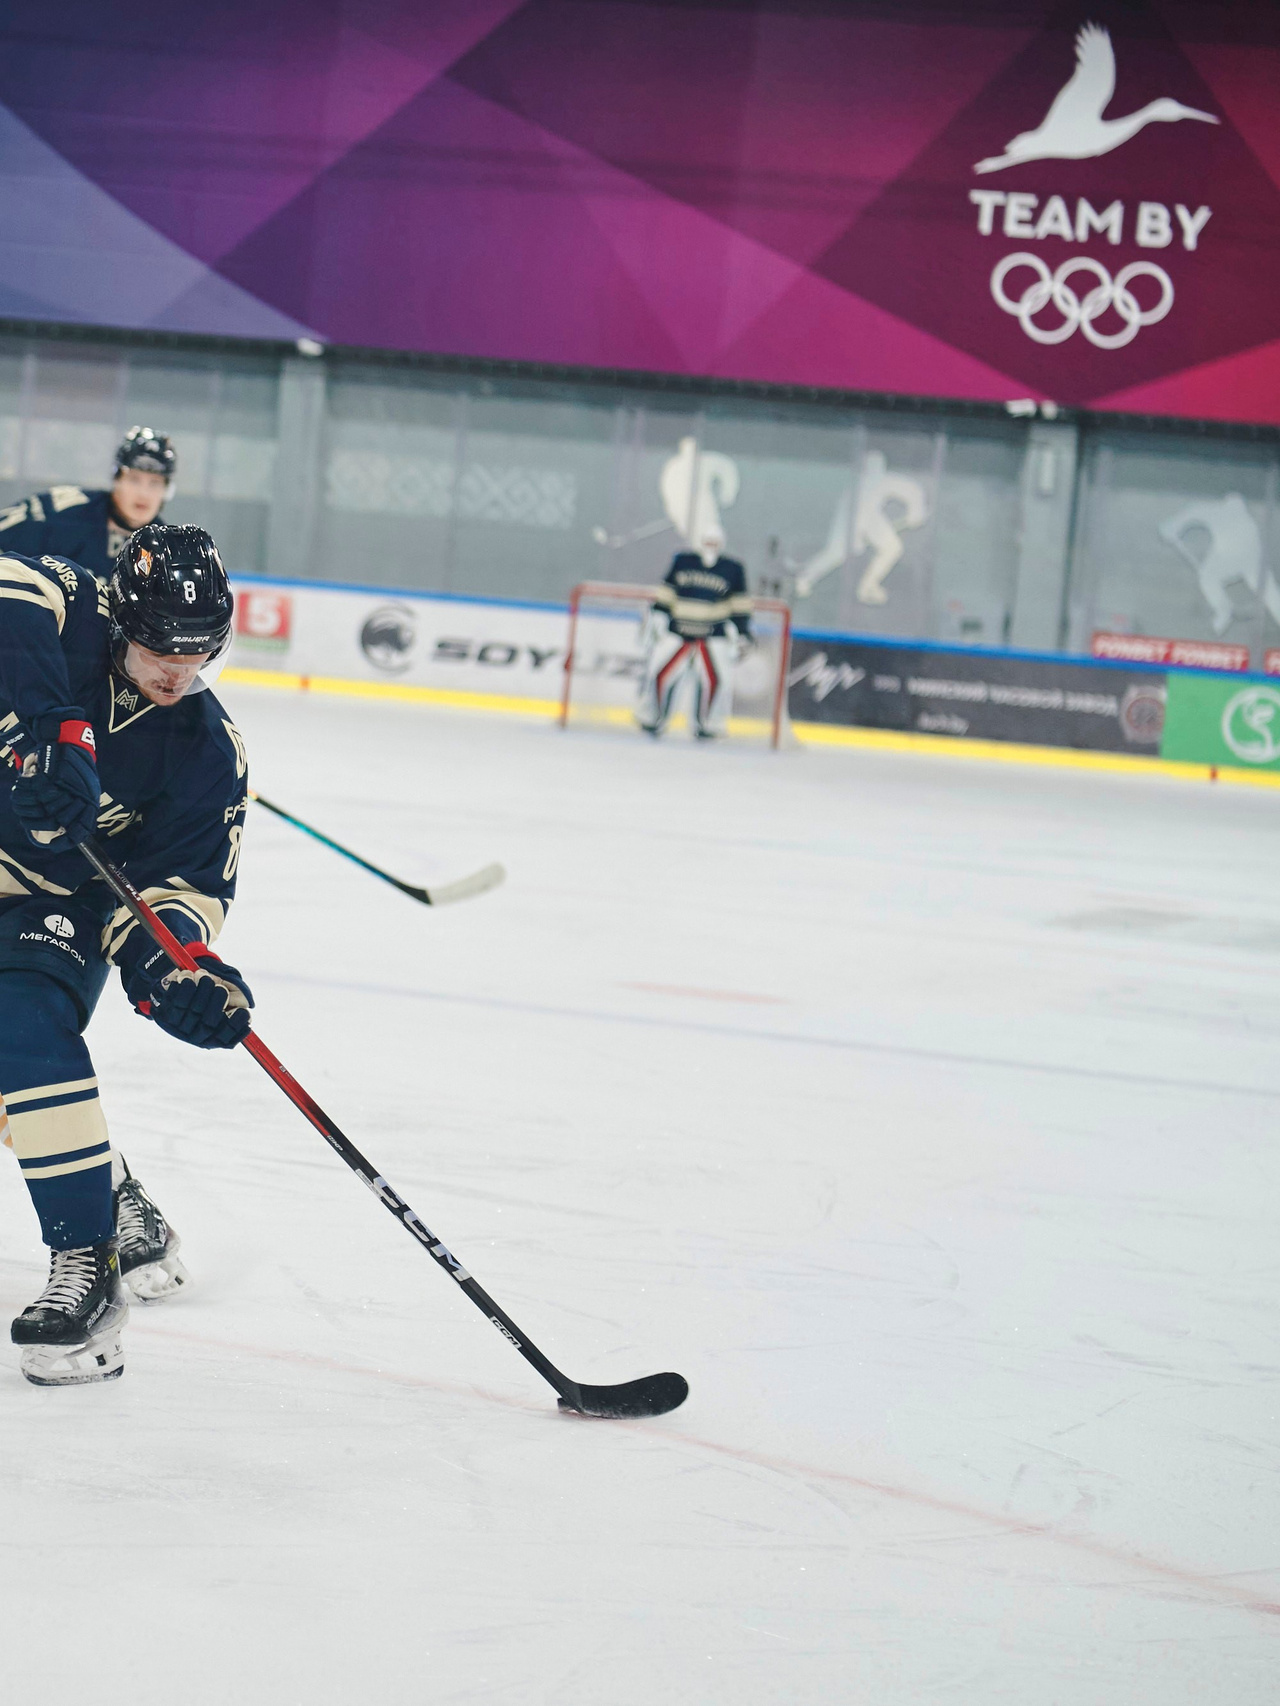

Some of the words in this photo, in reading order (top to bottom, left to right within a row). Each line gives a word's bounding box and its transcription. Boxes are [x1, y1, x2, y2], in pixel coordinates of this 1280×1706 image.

[968, 189, 1124, 246] TEAM
[1134, 201, 1213, 251] BY
[40, 555, 78, 601] FONBE
[183, 580, 197, 602] 8
[171, 635, 211, 643] BAUER
[223, 825, 243, 881] 8
[19, 932, 86, 967] МЕГАФОН
[144, 949, 166, 970] BAUE
[373, 1175, 471, 1282] CCM
[86, 1297, 108, 1330] BAUER
[491, 1318, 520, 1346] CCM
